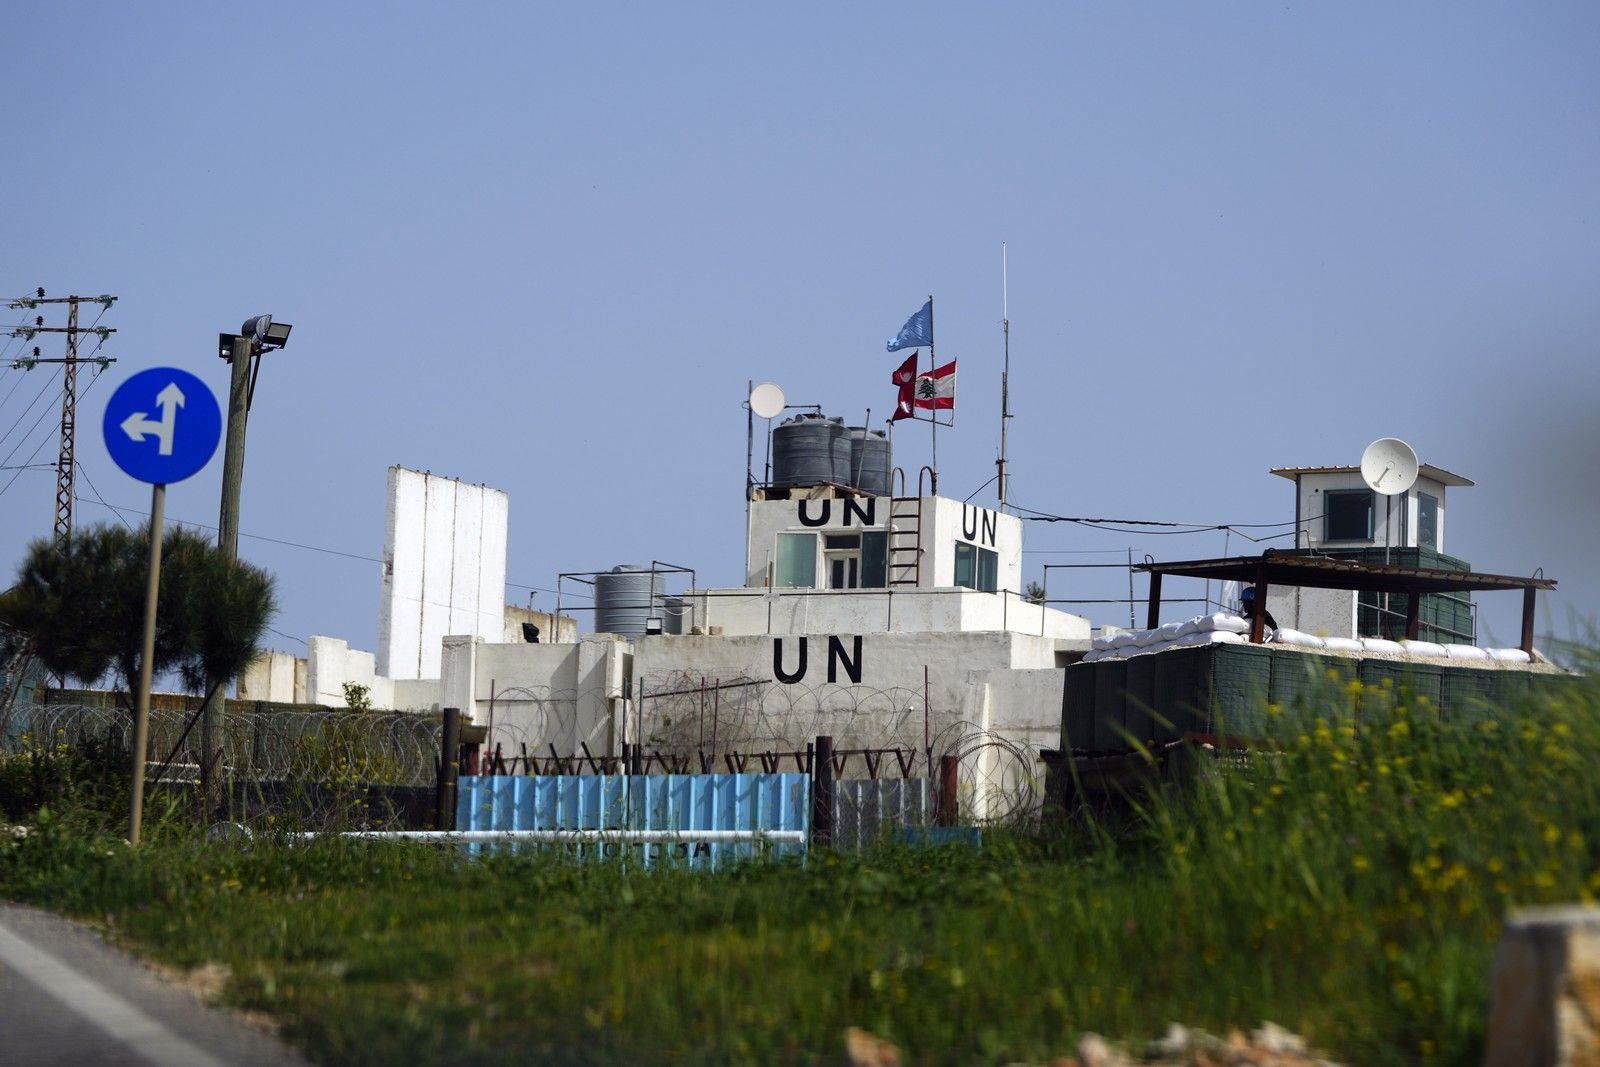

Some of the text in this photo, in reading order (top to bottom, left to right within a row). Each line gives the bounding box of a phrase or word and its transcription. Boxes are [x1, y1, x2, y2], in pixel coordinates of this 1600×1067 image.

[798, 498, 876, 527] UN
[962, 503, 997, 548] UN
[773, 635, 863, 685] UN
